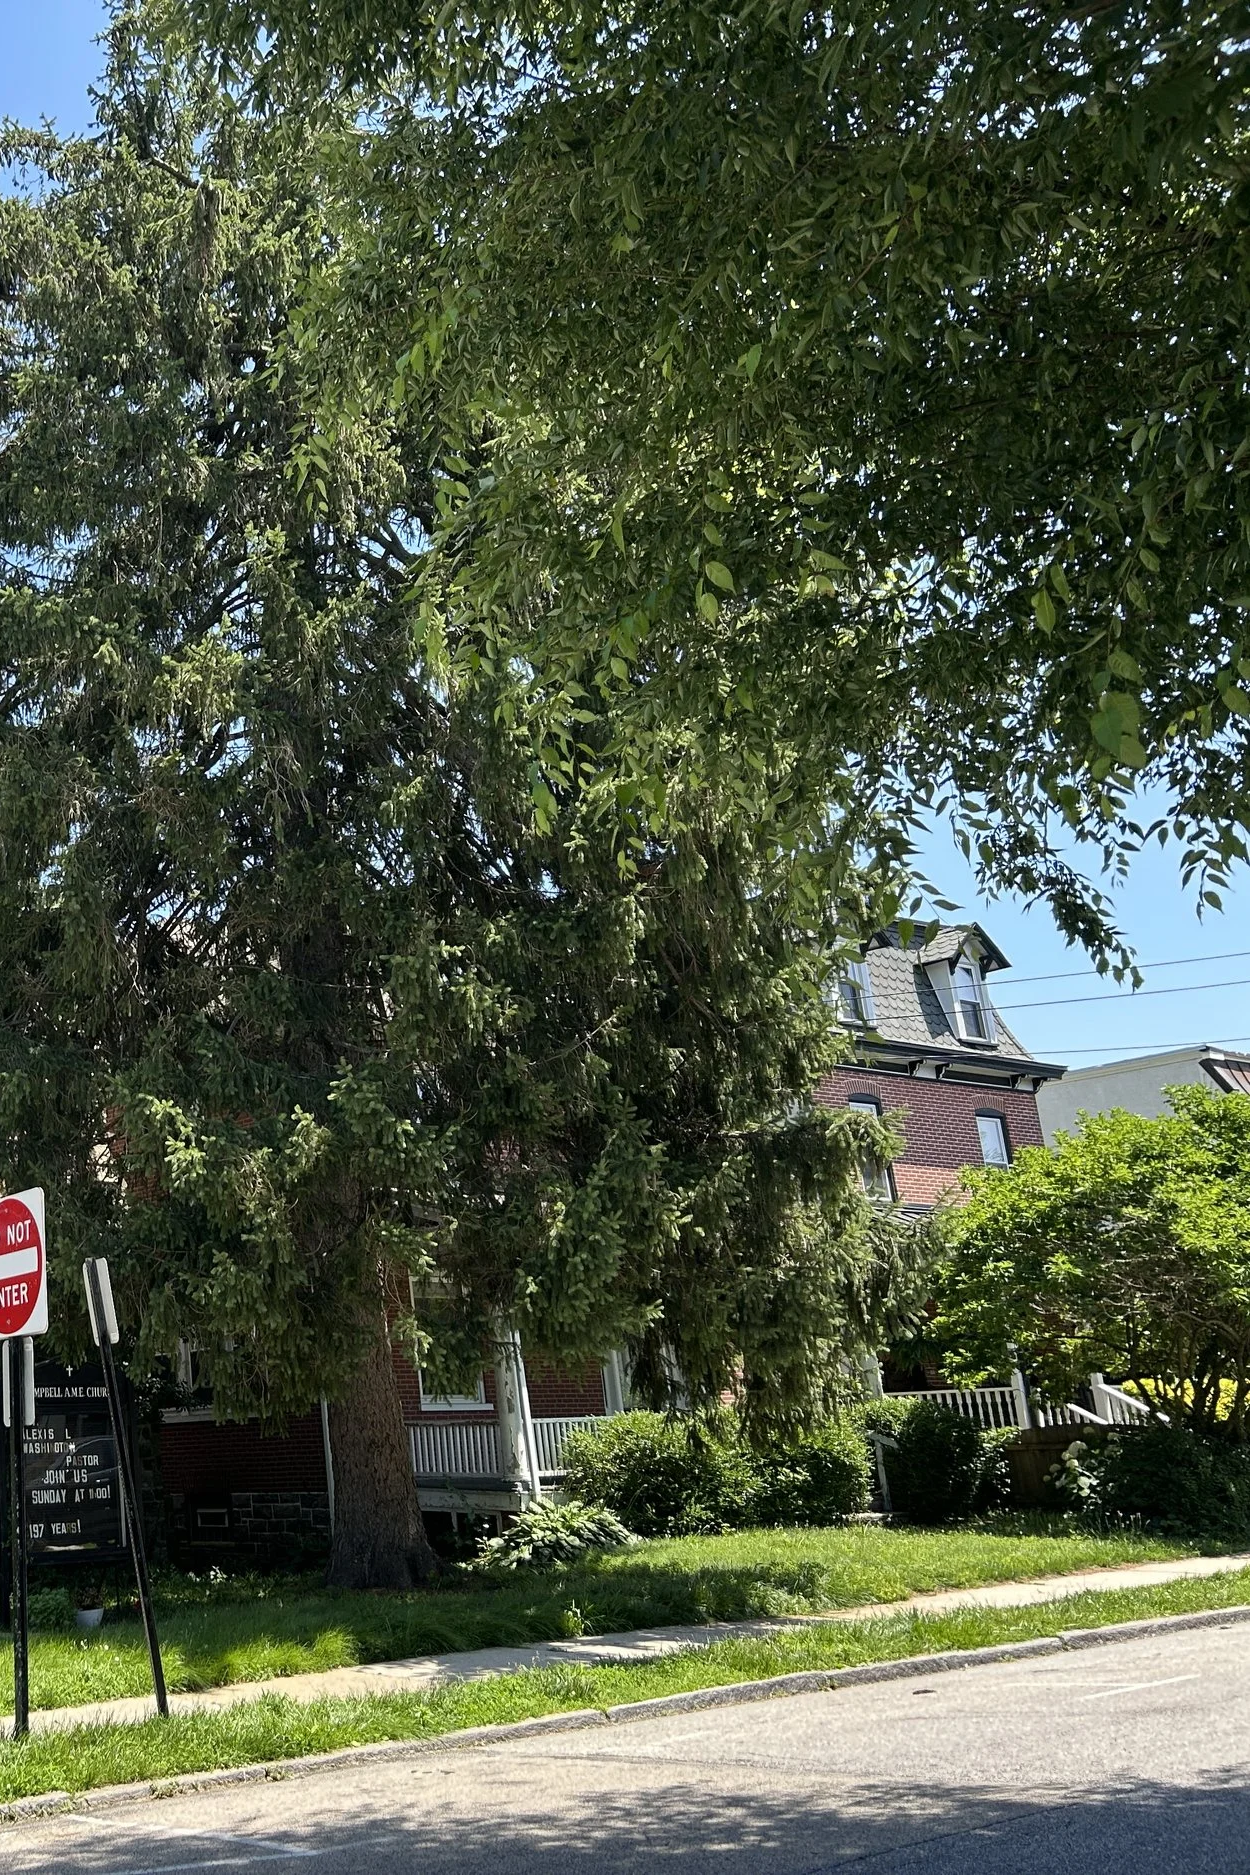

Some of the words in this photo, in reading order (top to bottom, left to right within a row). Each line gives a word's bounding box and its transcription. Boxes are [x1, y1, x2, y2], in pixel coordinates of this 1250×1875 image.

[7, 1219, 32, 1246] NOT
[34, 1386, 63, 1398] MPBELL
[86, 1386, 108, 1398] CHUR
[65, 1428, 71, 1440] L
[66, 1455, 100, 1467] PASTOR
[43, 1469, 66, 1484] JOIN
[73, 1469, 88, 1483] US
[31, 1489, 66, 1504] SUNDAY
[75, 1489, 85, 1503] AT
[29, 1523, 44, 1539] 197
[51, 1518, 81, 1535] YEARS!
